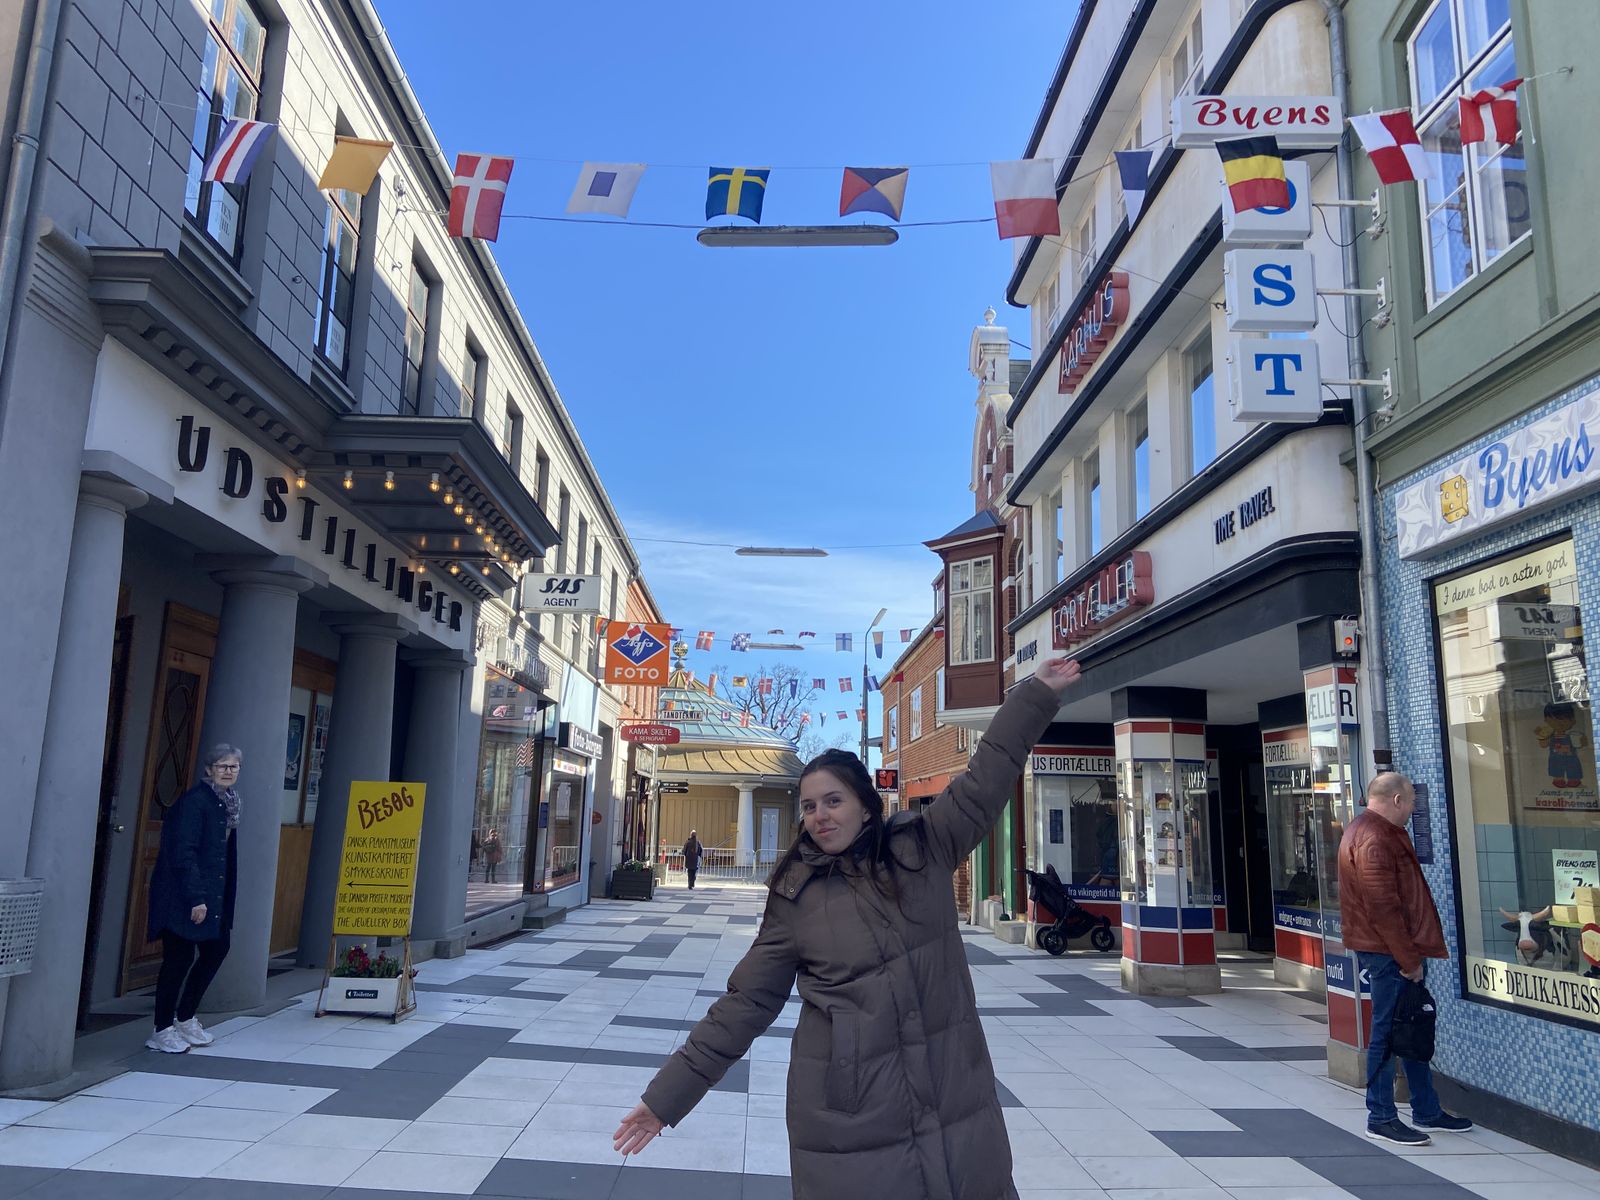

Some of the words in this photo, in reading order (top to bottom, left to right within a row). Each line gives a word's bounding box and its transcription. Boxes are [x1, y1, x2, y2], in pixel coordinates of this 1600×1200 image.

[1192, 98, 1331, 129] Byens
[1060, 278, 1115, 388] AARHUS
[1479, 422, 1595, 509] Byens
[1213, 510, 1236, 546] TIME
[1237, 485, 1276, 530] TRAVEL
[176, 415, 463, 633] UDSTILLINGER
[1451, 583, 1476, 602] denne
[1478, 576, 1497, 596] bod
[1499, 574, 1511, 587] er
[1511, 561, 1544, 583] osten
[1545, 550, 1568, 579] god
[539, 577, 585, 594] SAS
[543, 598, 579, 607] AGENT
[614, 667, 660, 680] FOTO
[650, 728, 672, 736] SKILTE
[1049, 757, 1112, 772] FORTÆLLER
[357, 786, 414, 830] BESØG
[347, 836, 367, 848] DANSK
[368, 836, 416, 849] PLAKATMUSEUM
[345, 851, 415, 865] KUNSTKAMMERET
[344, 866, 410, 880] SMYKKESKRINET
[338, 892, 348, 903] THE
[348, 892, 369, 904] DANISH
[389, 893, 413, 905] MUSEUM
[1067, 886, 1077, 897] fra
[1077, 887, 1108, 899] vikingetid
[1108, 888, 1116, 898] til
[337, 916, 350, 928] THE
[351, 916, 391, 929] JEWELLERY
[392, 918, 408, 929] BOX
[1473, 963, 1497, 992] OST
[1505, 969, 1600, 1015] DELIKATESS
